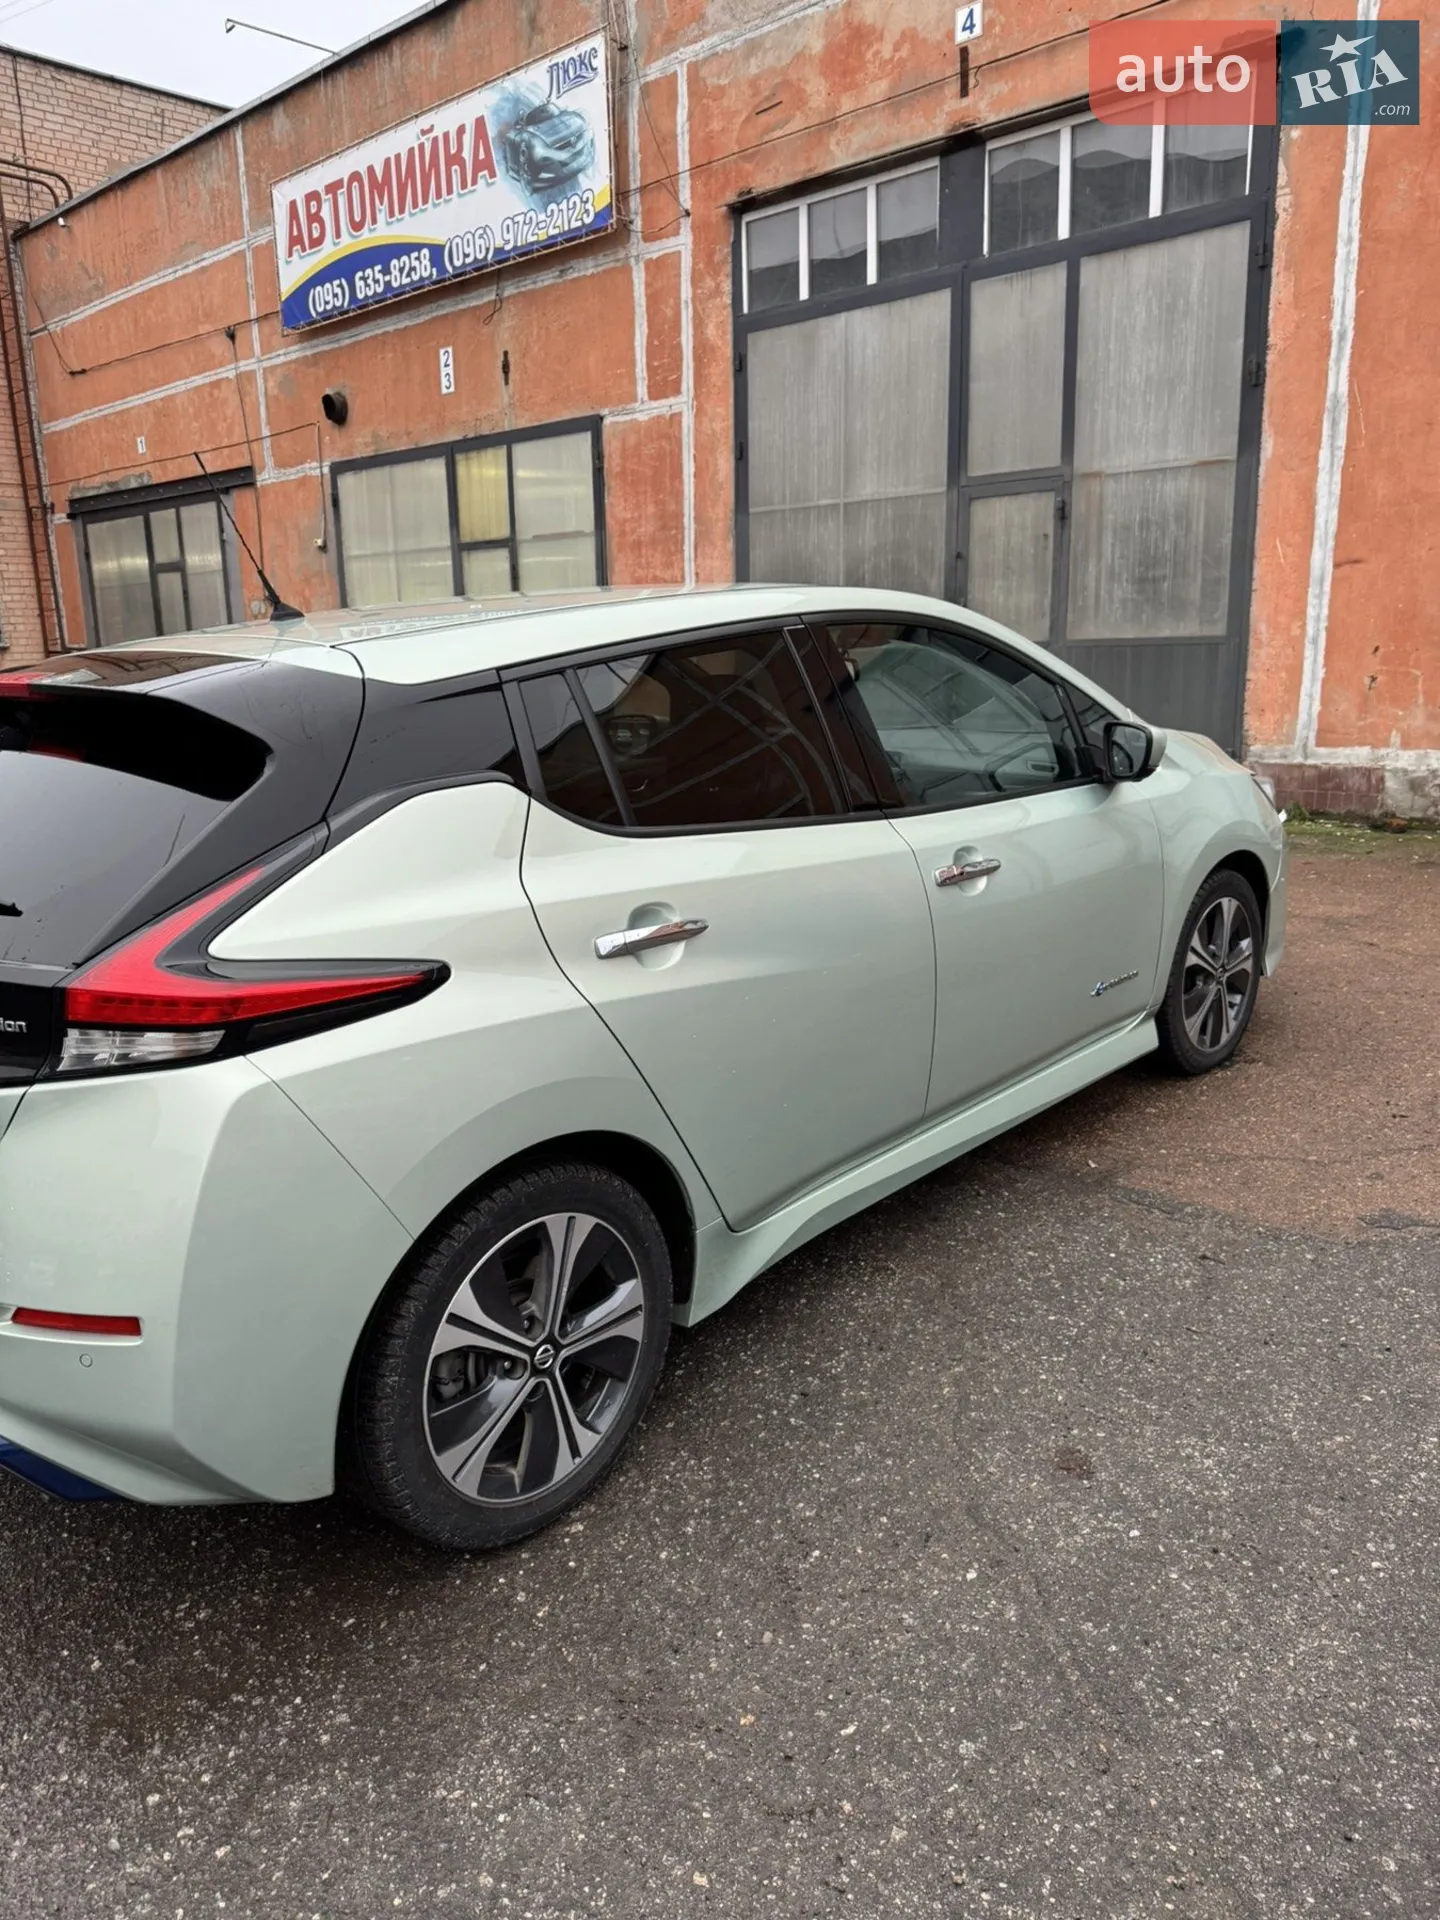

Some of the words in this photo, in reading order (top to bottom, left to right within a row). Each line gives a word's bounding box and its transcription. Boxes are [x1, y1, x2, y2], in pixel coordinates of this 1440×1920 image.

[961, 7, 976, 35] 4
[286, 115, 498, 260] АВТОМИЙКА
[308, 278, 350, 318] (095)
[354, 249, 438, 300] 635-8258,
[444, 224, 495, 274] (096)
[501, 189, 596, 252] 972-2123
[443, 350, 451, 368] 2
[444, 372, 452, 390] 3
